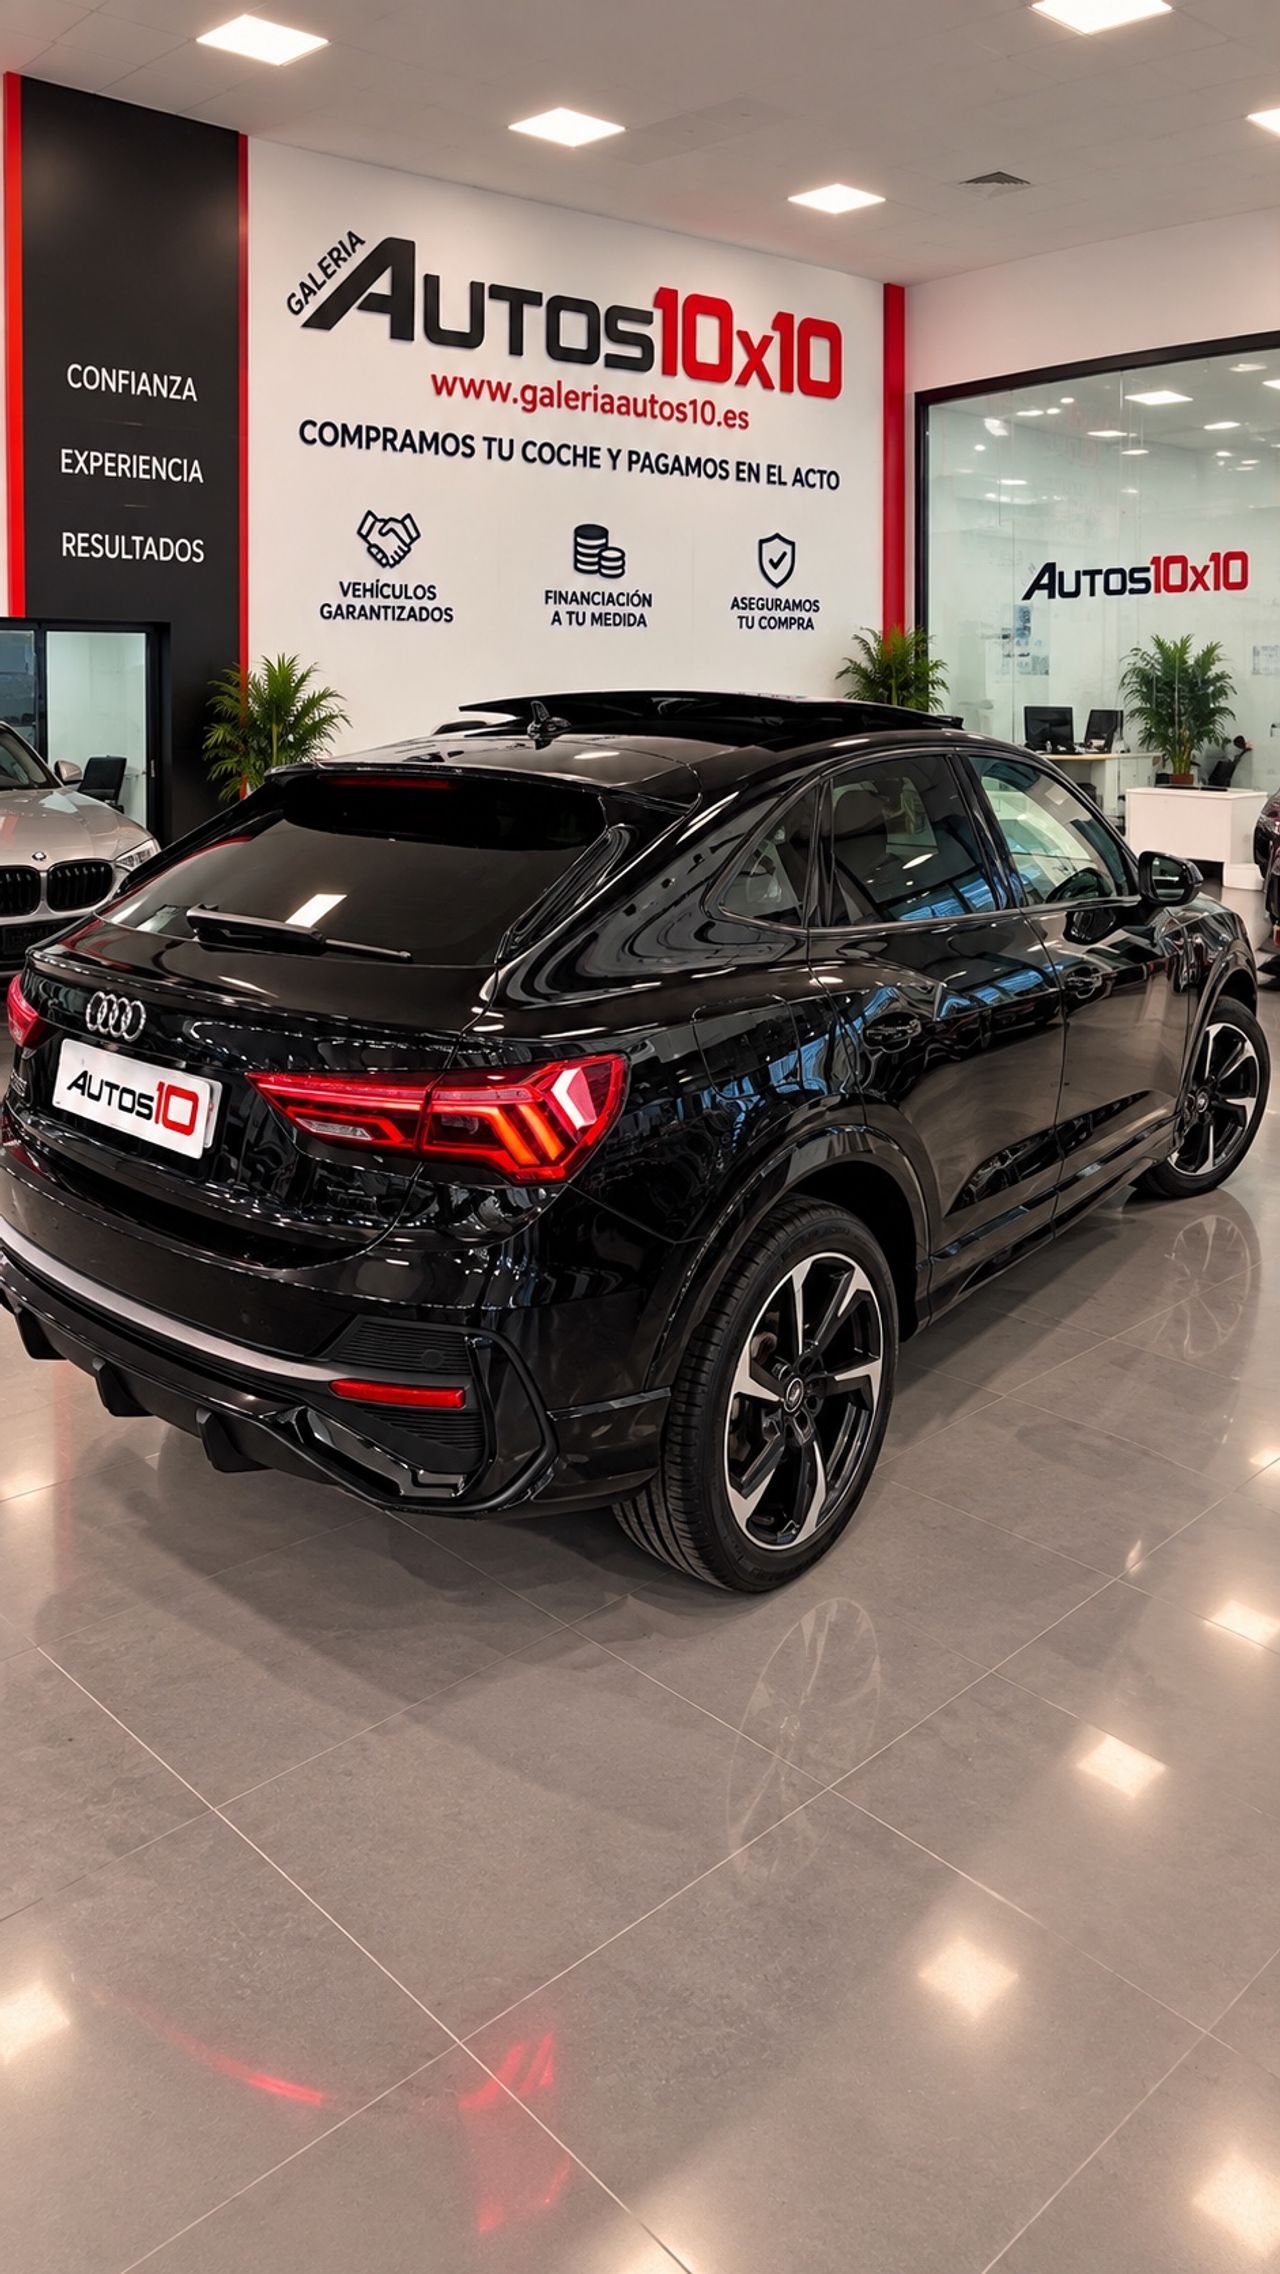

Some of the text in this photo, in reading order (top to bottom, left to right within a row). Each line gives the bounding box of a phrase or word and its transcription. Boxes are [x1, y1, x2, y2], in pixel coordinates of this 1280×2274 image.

[286, 230, 366, 316] GALERIA
[67, 363, 198, 402] CONFIANZA
[430, 373, 750, 430] www.galeriaautos10.es
[60, 447, 204, 484] EXPERIENCIA
[298, 418, 841, 491] COMPRAMOS TU COCHE Y PAGAMOS EN EL ACTO
[61, 531, 205, 563] RESULTADOS
[339, 579, 438, 602] VEHÍCULOS
[544, 589, 653, 608] FINANCIACIÓN
[730, 595, 821, 613] ASEGURAMOS
[319, 602, 455, 624] GARANTIZADOS
[550, 611, 648, 629] A TU MEDIDA
[737, 615, 815, 631] TU COMPRA
[66, 1070, 200, 1136] AUTOS10
